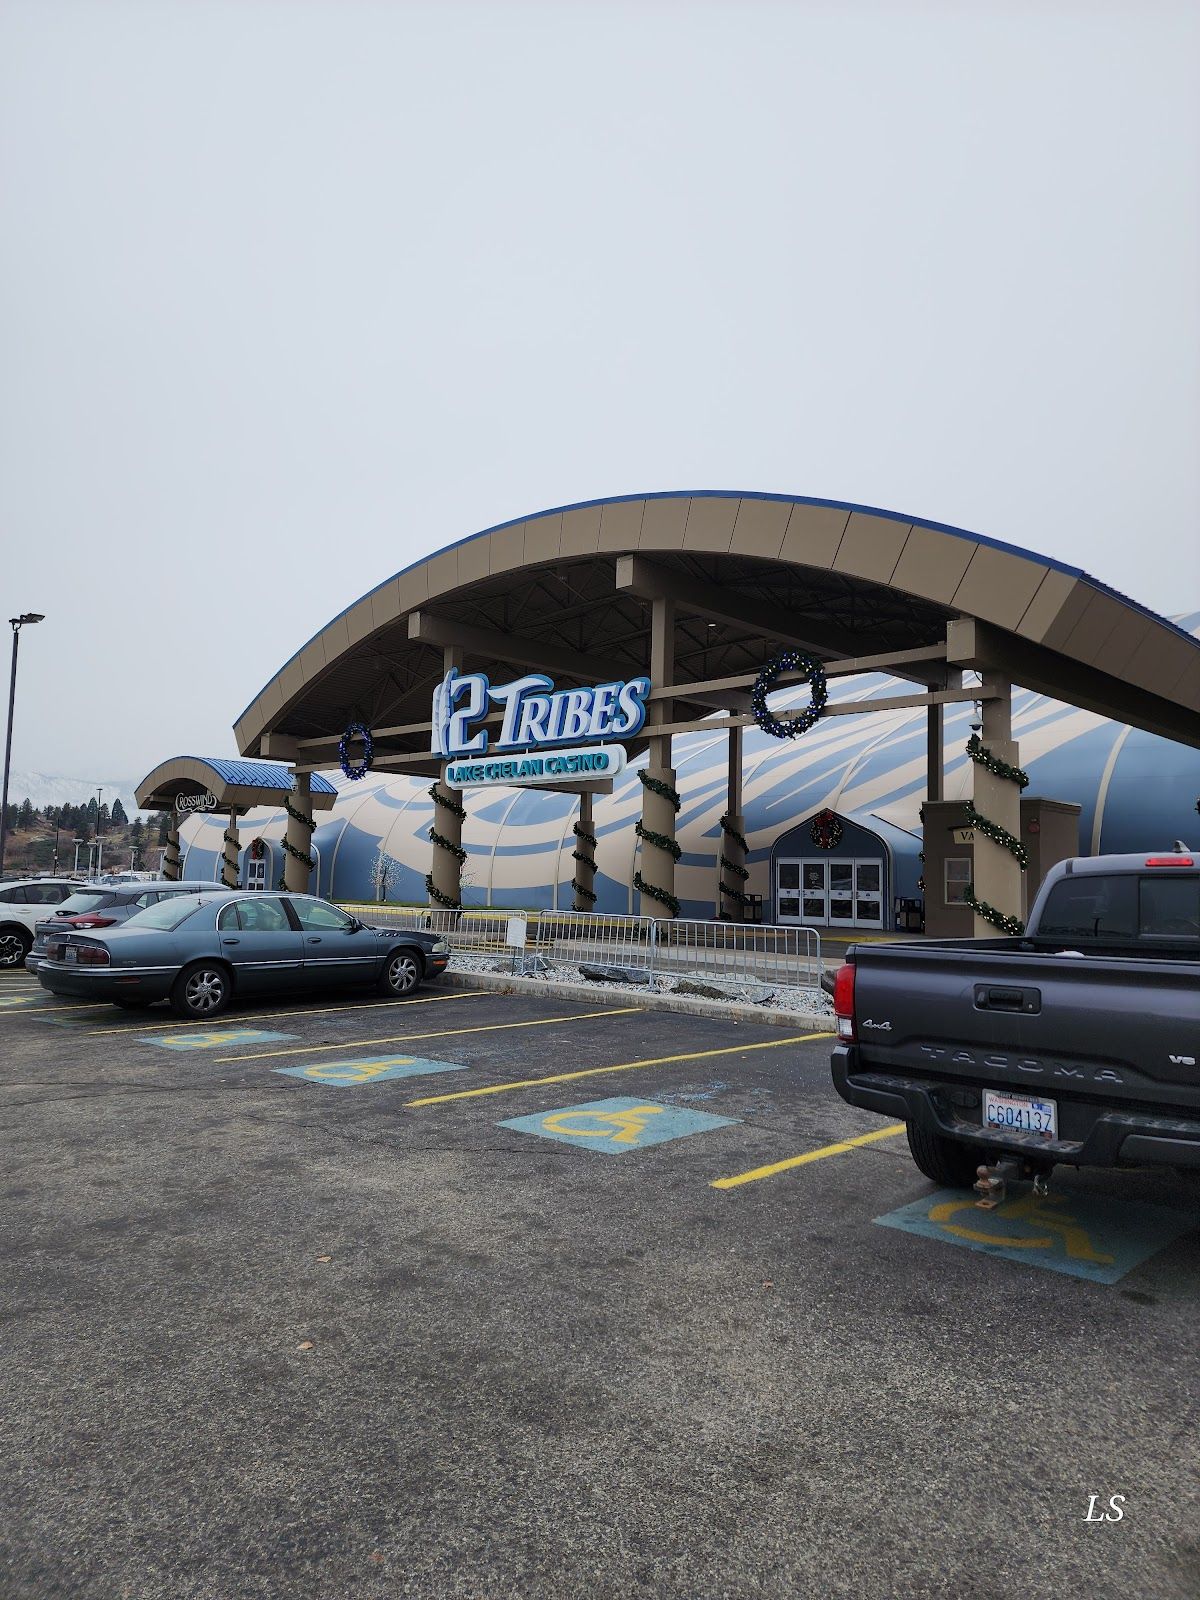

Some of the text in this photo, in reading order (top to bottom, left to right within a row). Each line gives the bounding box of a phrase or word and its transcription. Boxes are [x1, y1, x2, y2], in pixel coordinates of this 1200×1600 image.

[486, 674, 649, 748] TRIBES
[447, 752, 609, 783] LAKE CHELAN CASINO
[921, 1045, 1124, 1083] TACOMA
[1168, 1054, 1196, 1066] V6
